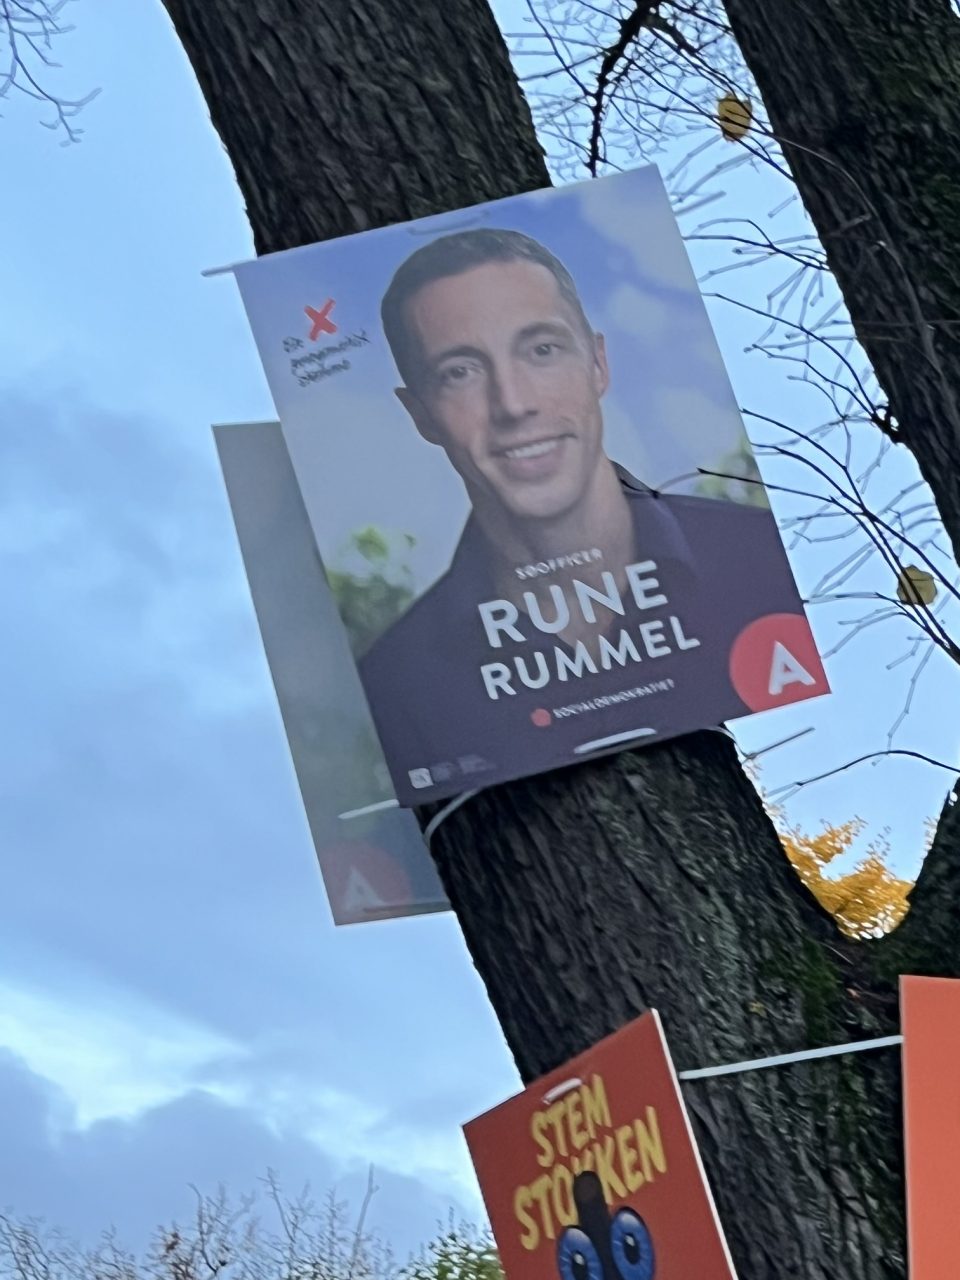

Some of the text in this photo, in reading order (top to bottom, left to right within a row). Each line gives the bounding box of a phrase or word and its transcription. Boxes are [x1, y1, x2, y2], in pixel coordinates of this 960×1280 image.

[478, 560, 668, 648] RUNE
[480, 616, 701, 700] RUMMEL
[768, 640, 816, 695] A
[531, 1073, 612, 1168] STEM
